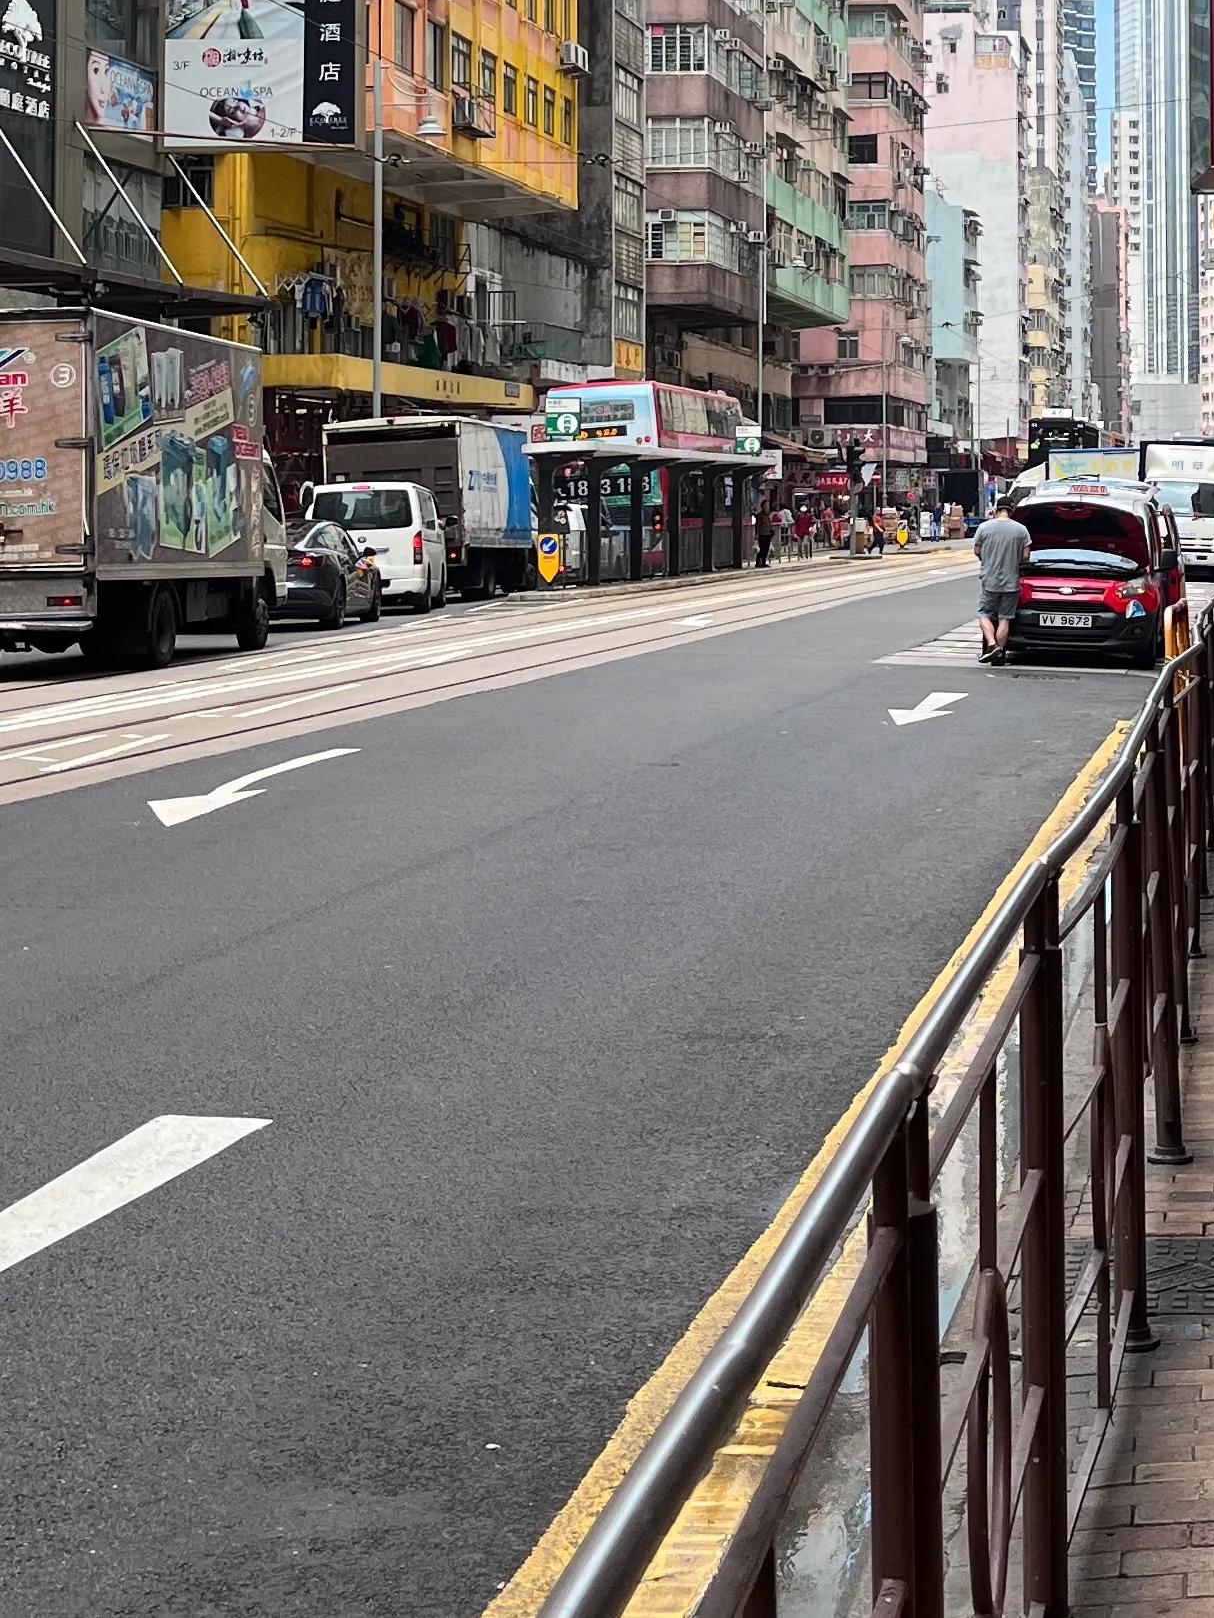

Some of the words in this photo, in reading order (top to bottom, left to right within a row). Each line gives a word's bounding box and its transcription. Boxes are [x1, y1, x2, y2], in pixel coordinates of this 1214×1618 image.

[172, 60, 191, 71] 3/F
[200, 86, 239, 97] OCEAN
[253, 86, 273, 97] SPA
[1041, 615, 1056, 625] VV
[1060, 616, 1090, 626] 9672
